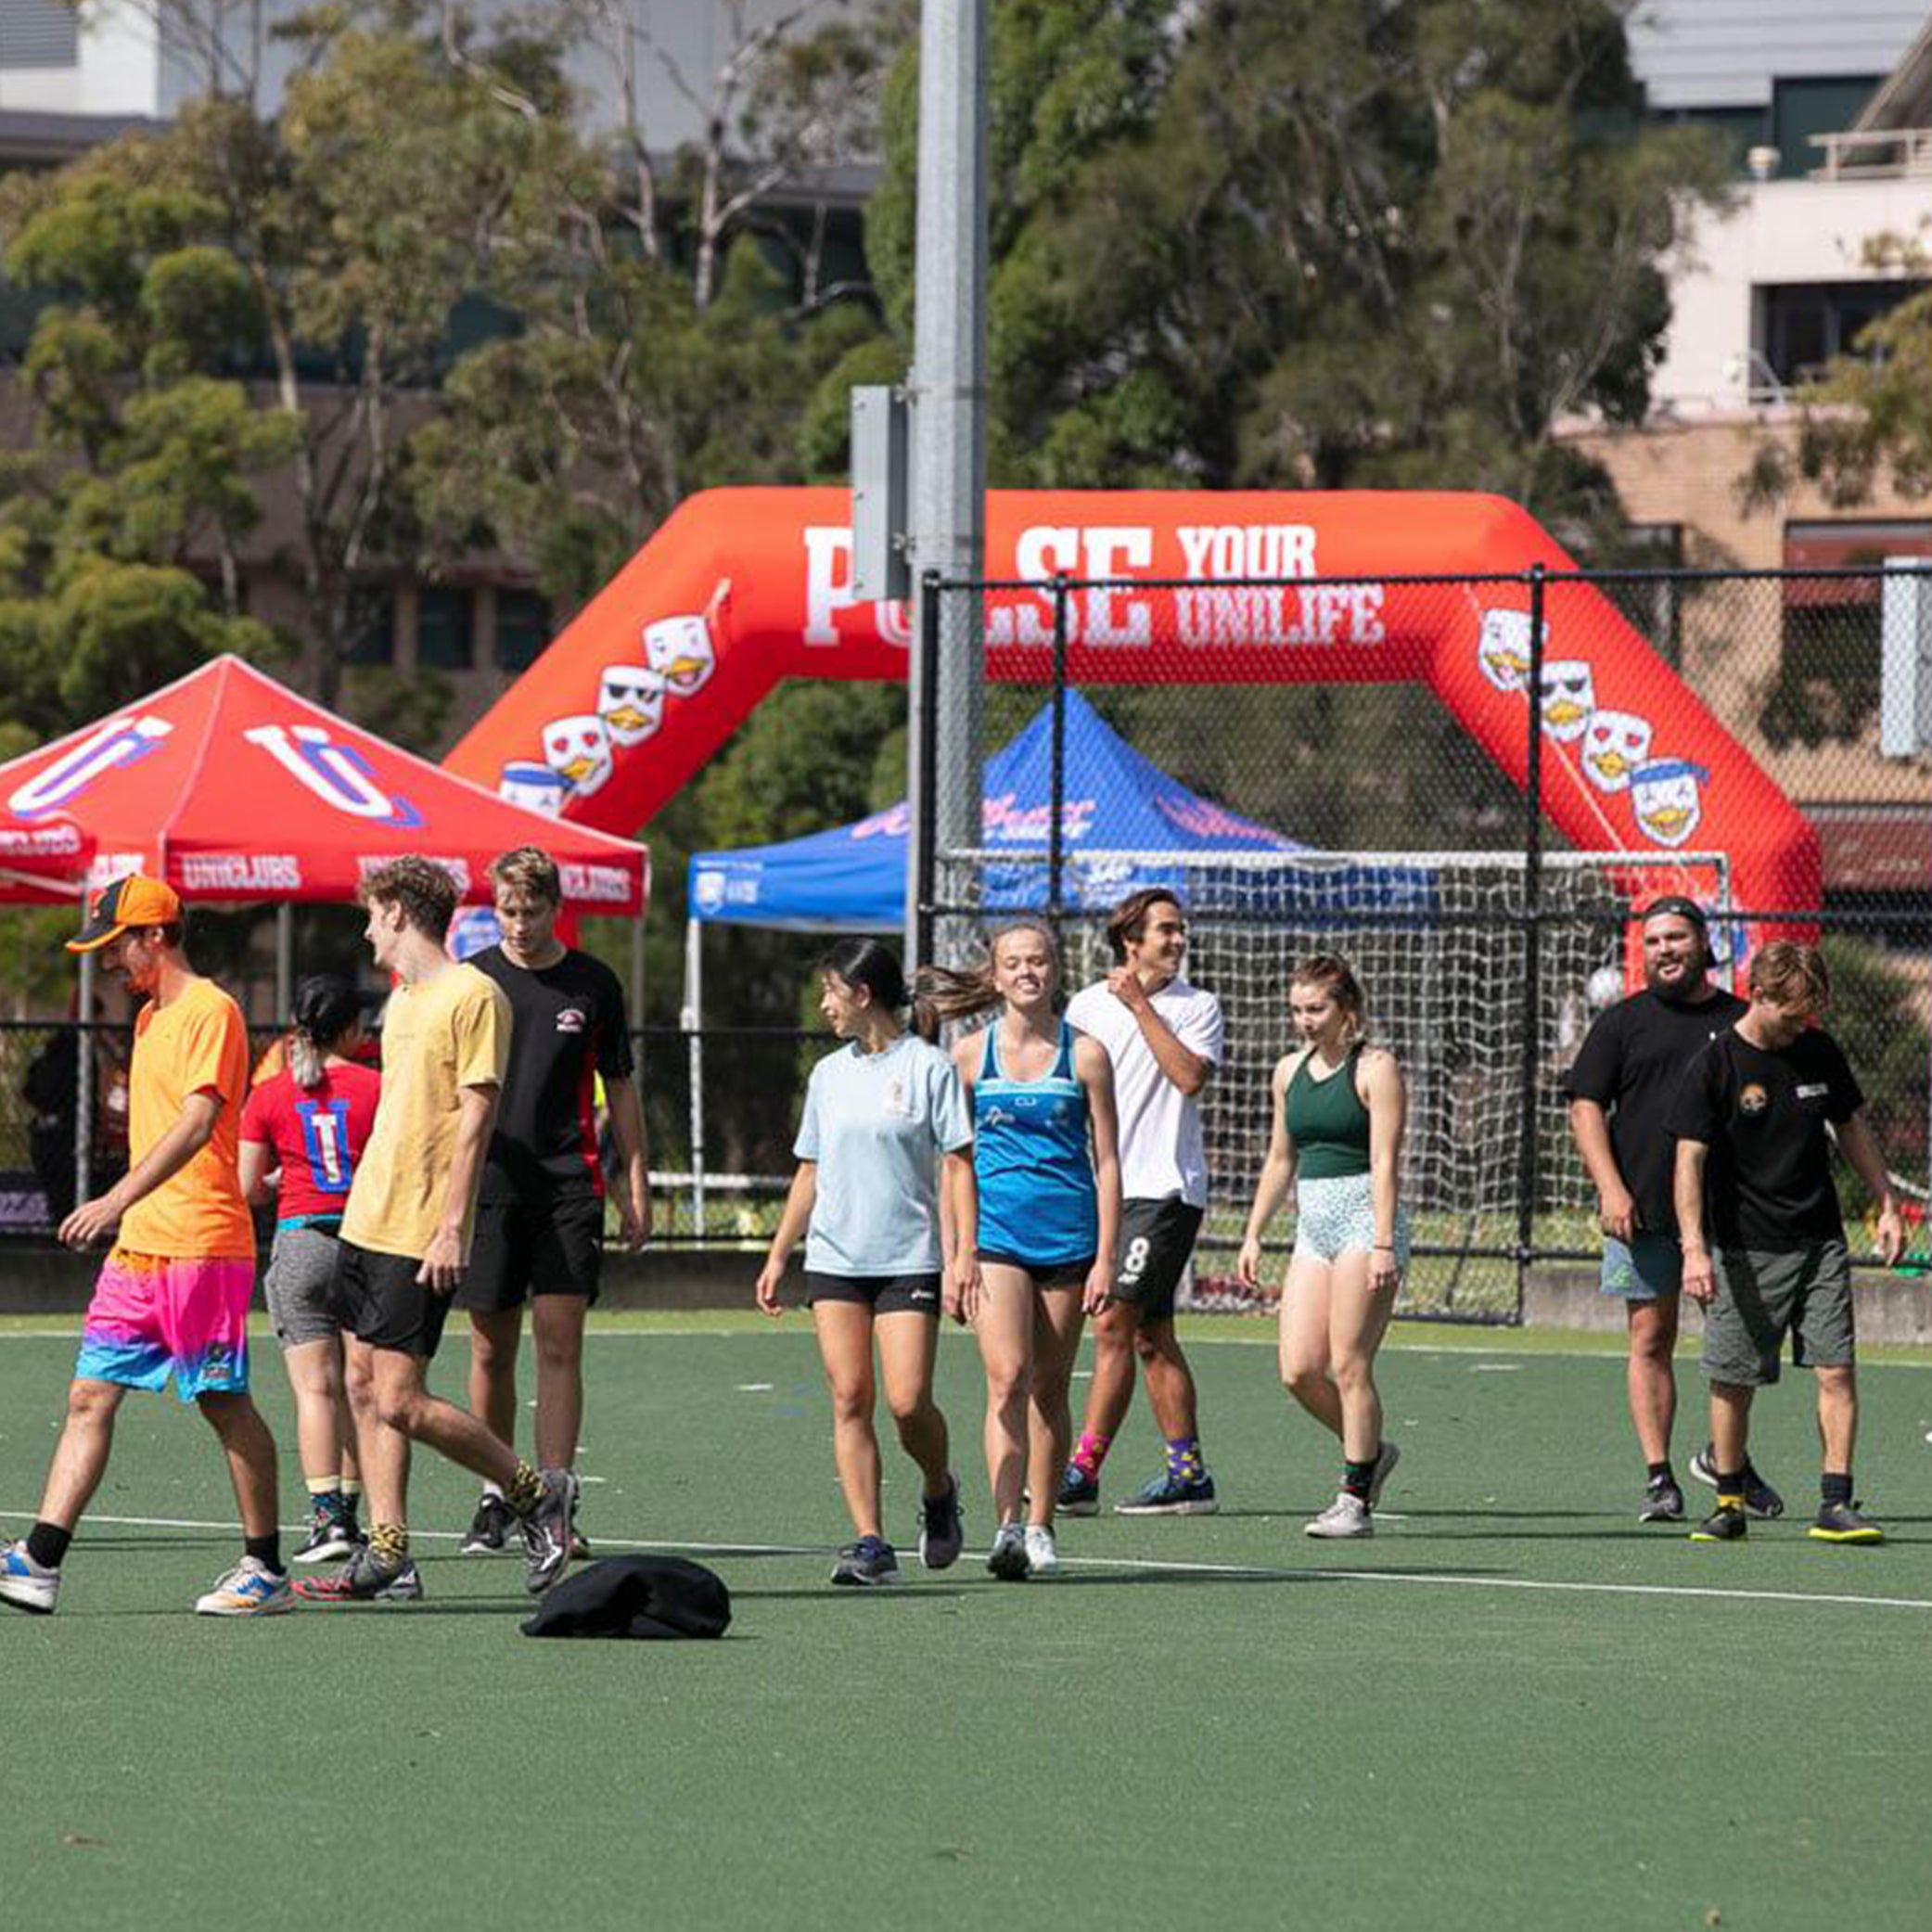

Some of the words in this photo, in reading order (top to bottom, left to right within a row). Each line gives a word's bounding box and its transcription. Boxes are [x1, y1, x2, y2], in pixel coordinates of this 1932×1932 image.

[1177, 525, 1317, 580] YOUR
[804, 525, 1152, 647] PSE
[1174, 584, 1386, 649] UNILIFE
[183, 853, 301, 889] UNICLUBS
[1125, 1235, 1150, 1274] 8
